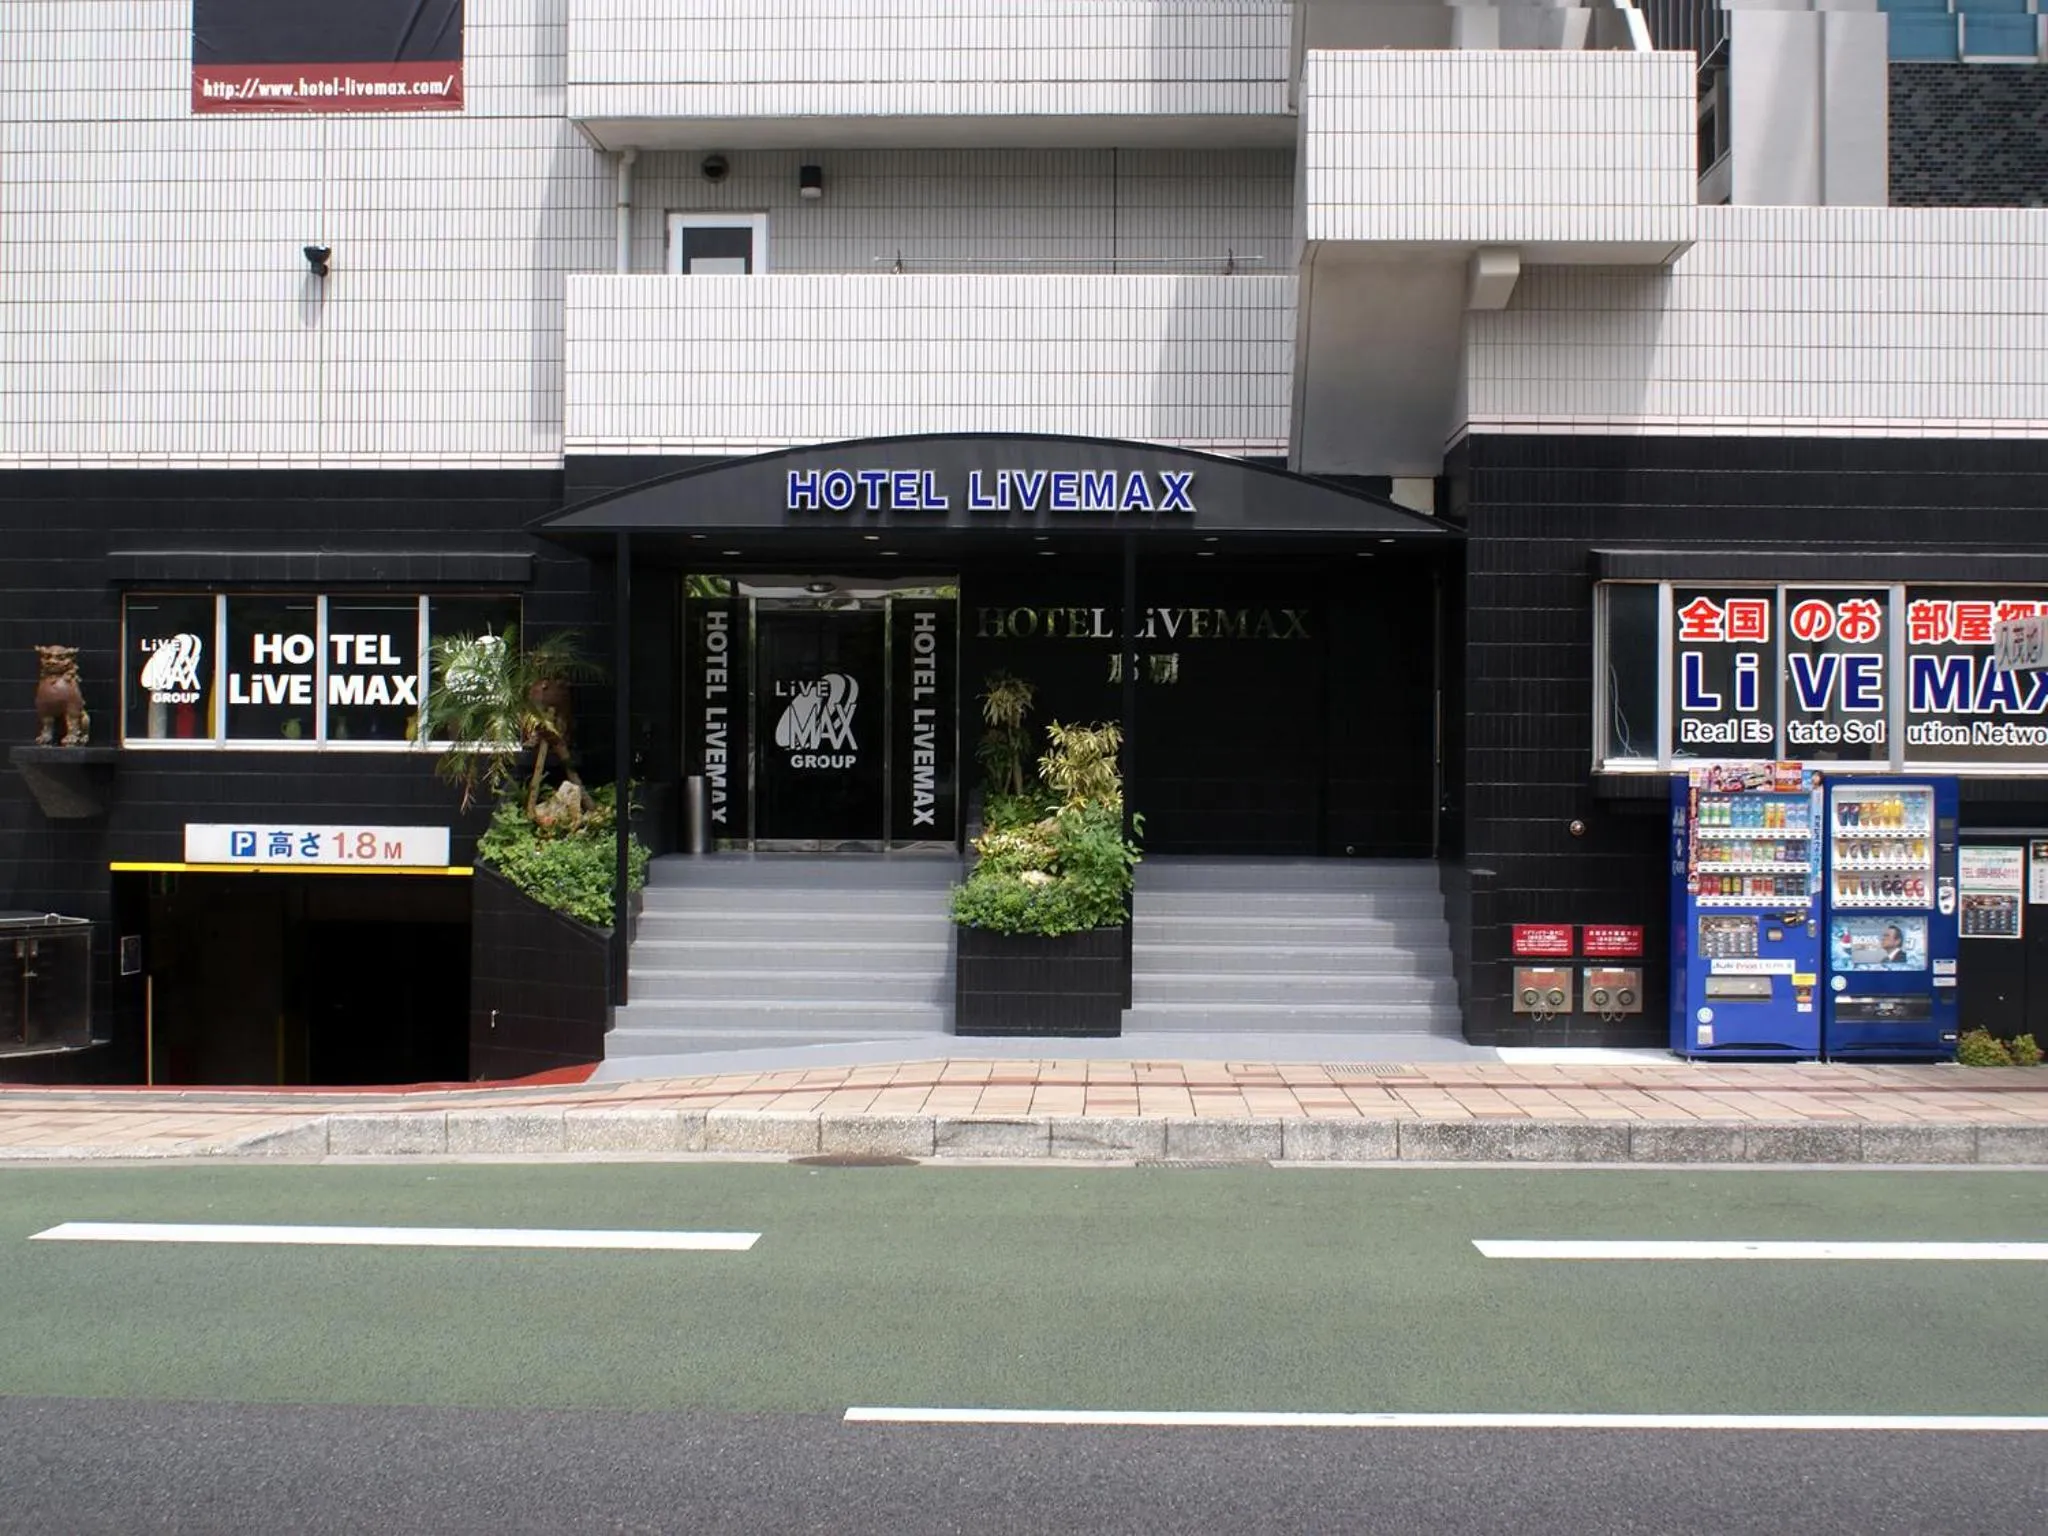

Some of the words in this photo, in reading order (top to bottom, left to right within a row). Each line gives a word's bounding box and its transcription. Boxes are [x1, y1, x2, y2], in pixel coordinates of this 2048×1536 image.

[203, 76, 454, 100] http://www.hotel-livemax.com/
[787, 469, 949, 510] HOTEL
[967, 469, 1198, 512] LiVEMAX
[976, 607, 1113, 638] HOTEL
[706, 611, 728, 699] HOTEL
[913, 612, 936, 700] HOTEL
[152, 692, 200, 703] GROUP
[229, 673, 312, 704] LiVE
[328, 674, 418, 705] MAX
[775, 680, 832, 697] LiVE
[788, 703, 858, 751] MAX
[1682, 719, 1736, 743] Real
[790, 754, 857, 769] GROUP
[912, 708, 936, 826] LiVEMAX
[268, 831, 321, 858] 高さ
[332, 832, 377, 858] 1.8
[384, 842, 403, 859] M
